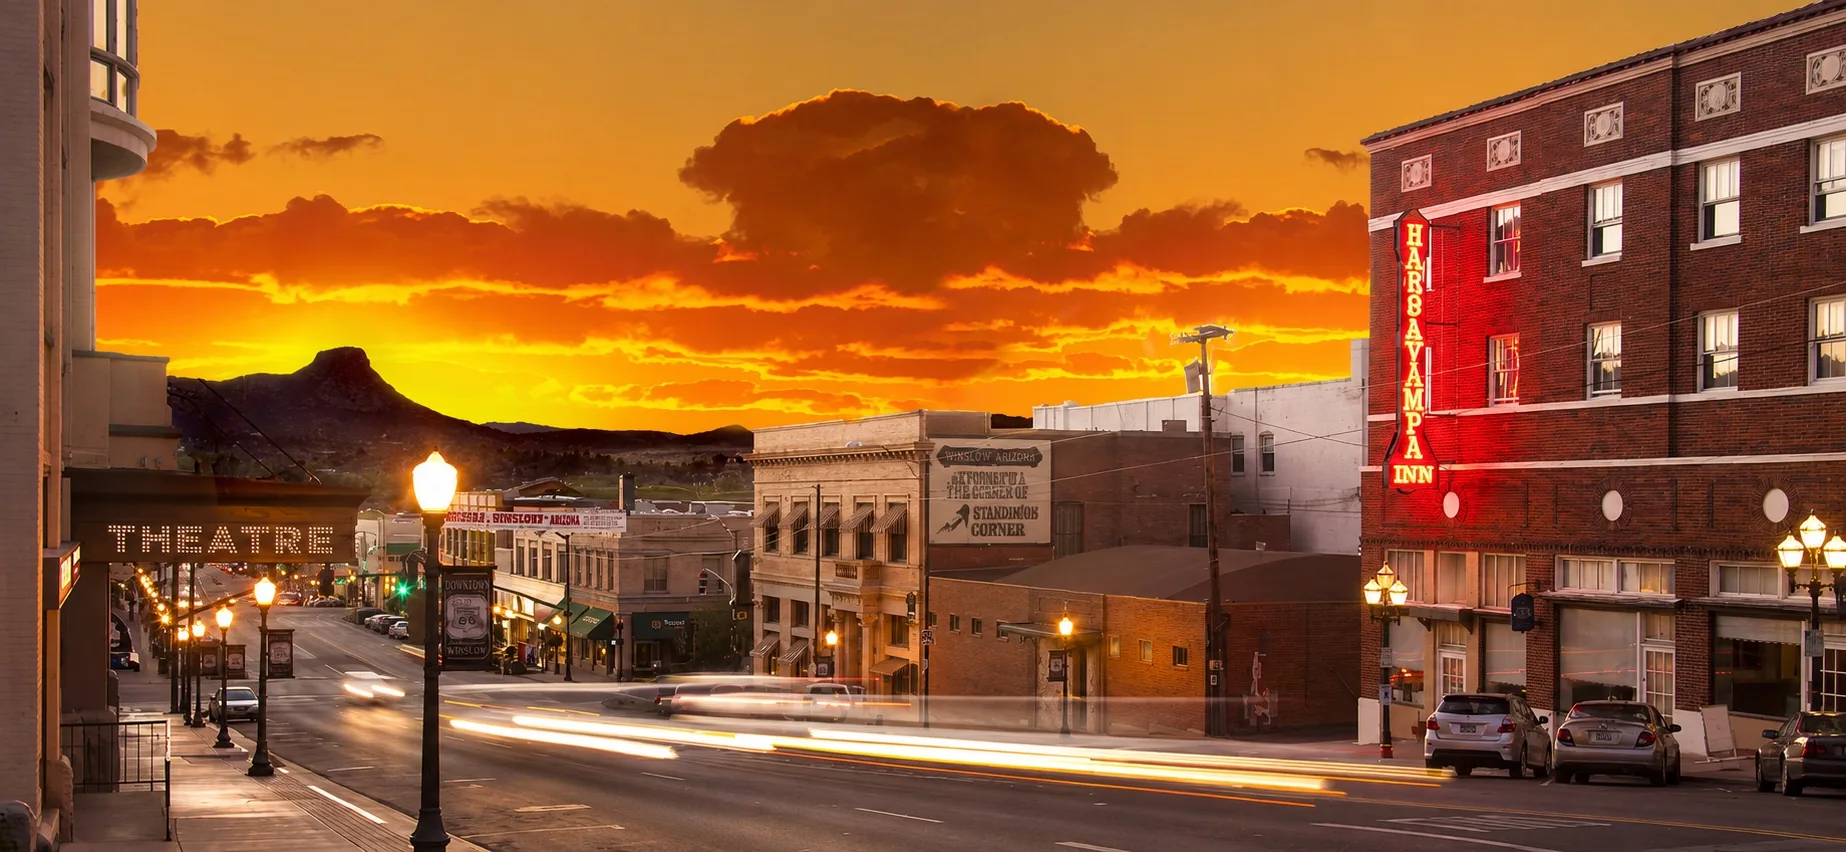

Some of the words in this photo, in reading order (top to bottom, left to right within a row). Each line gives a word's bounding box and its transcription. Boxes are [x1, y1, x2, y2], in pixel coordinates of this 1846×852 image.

[945, 451, 992, 462] WINSLOW
[1393, 465, 1435, 484] INN
[946, 485, 971, 500] THE
[970, 523, 1026, 537] CORNER
[108, 525, 333, 554] THEATRE
[447, 646, 487, 655] WINSLOW
